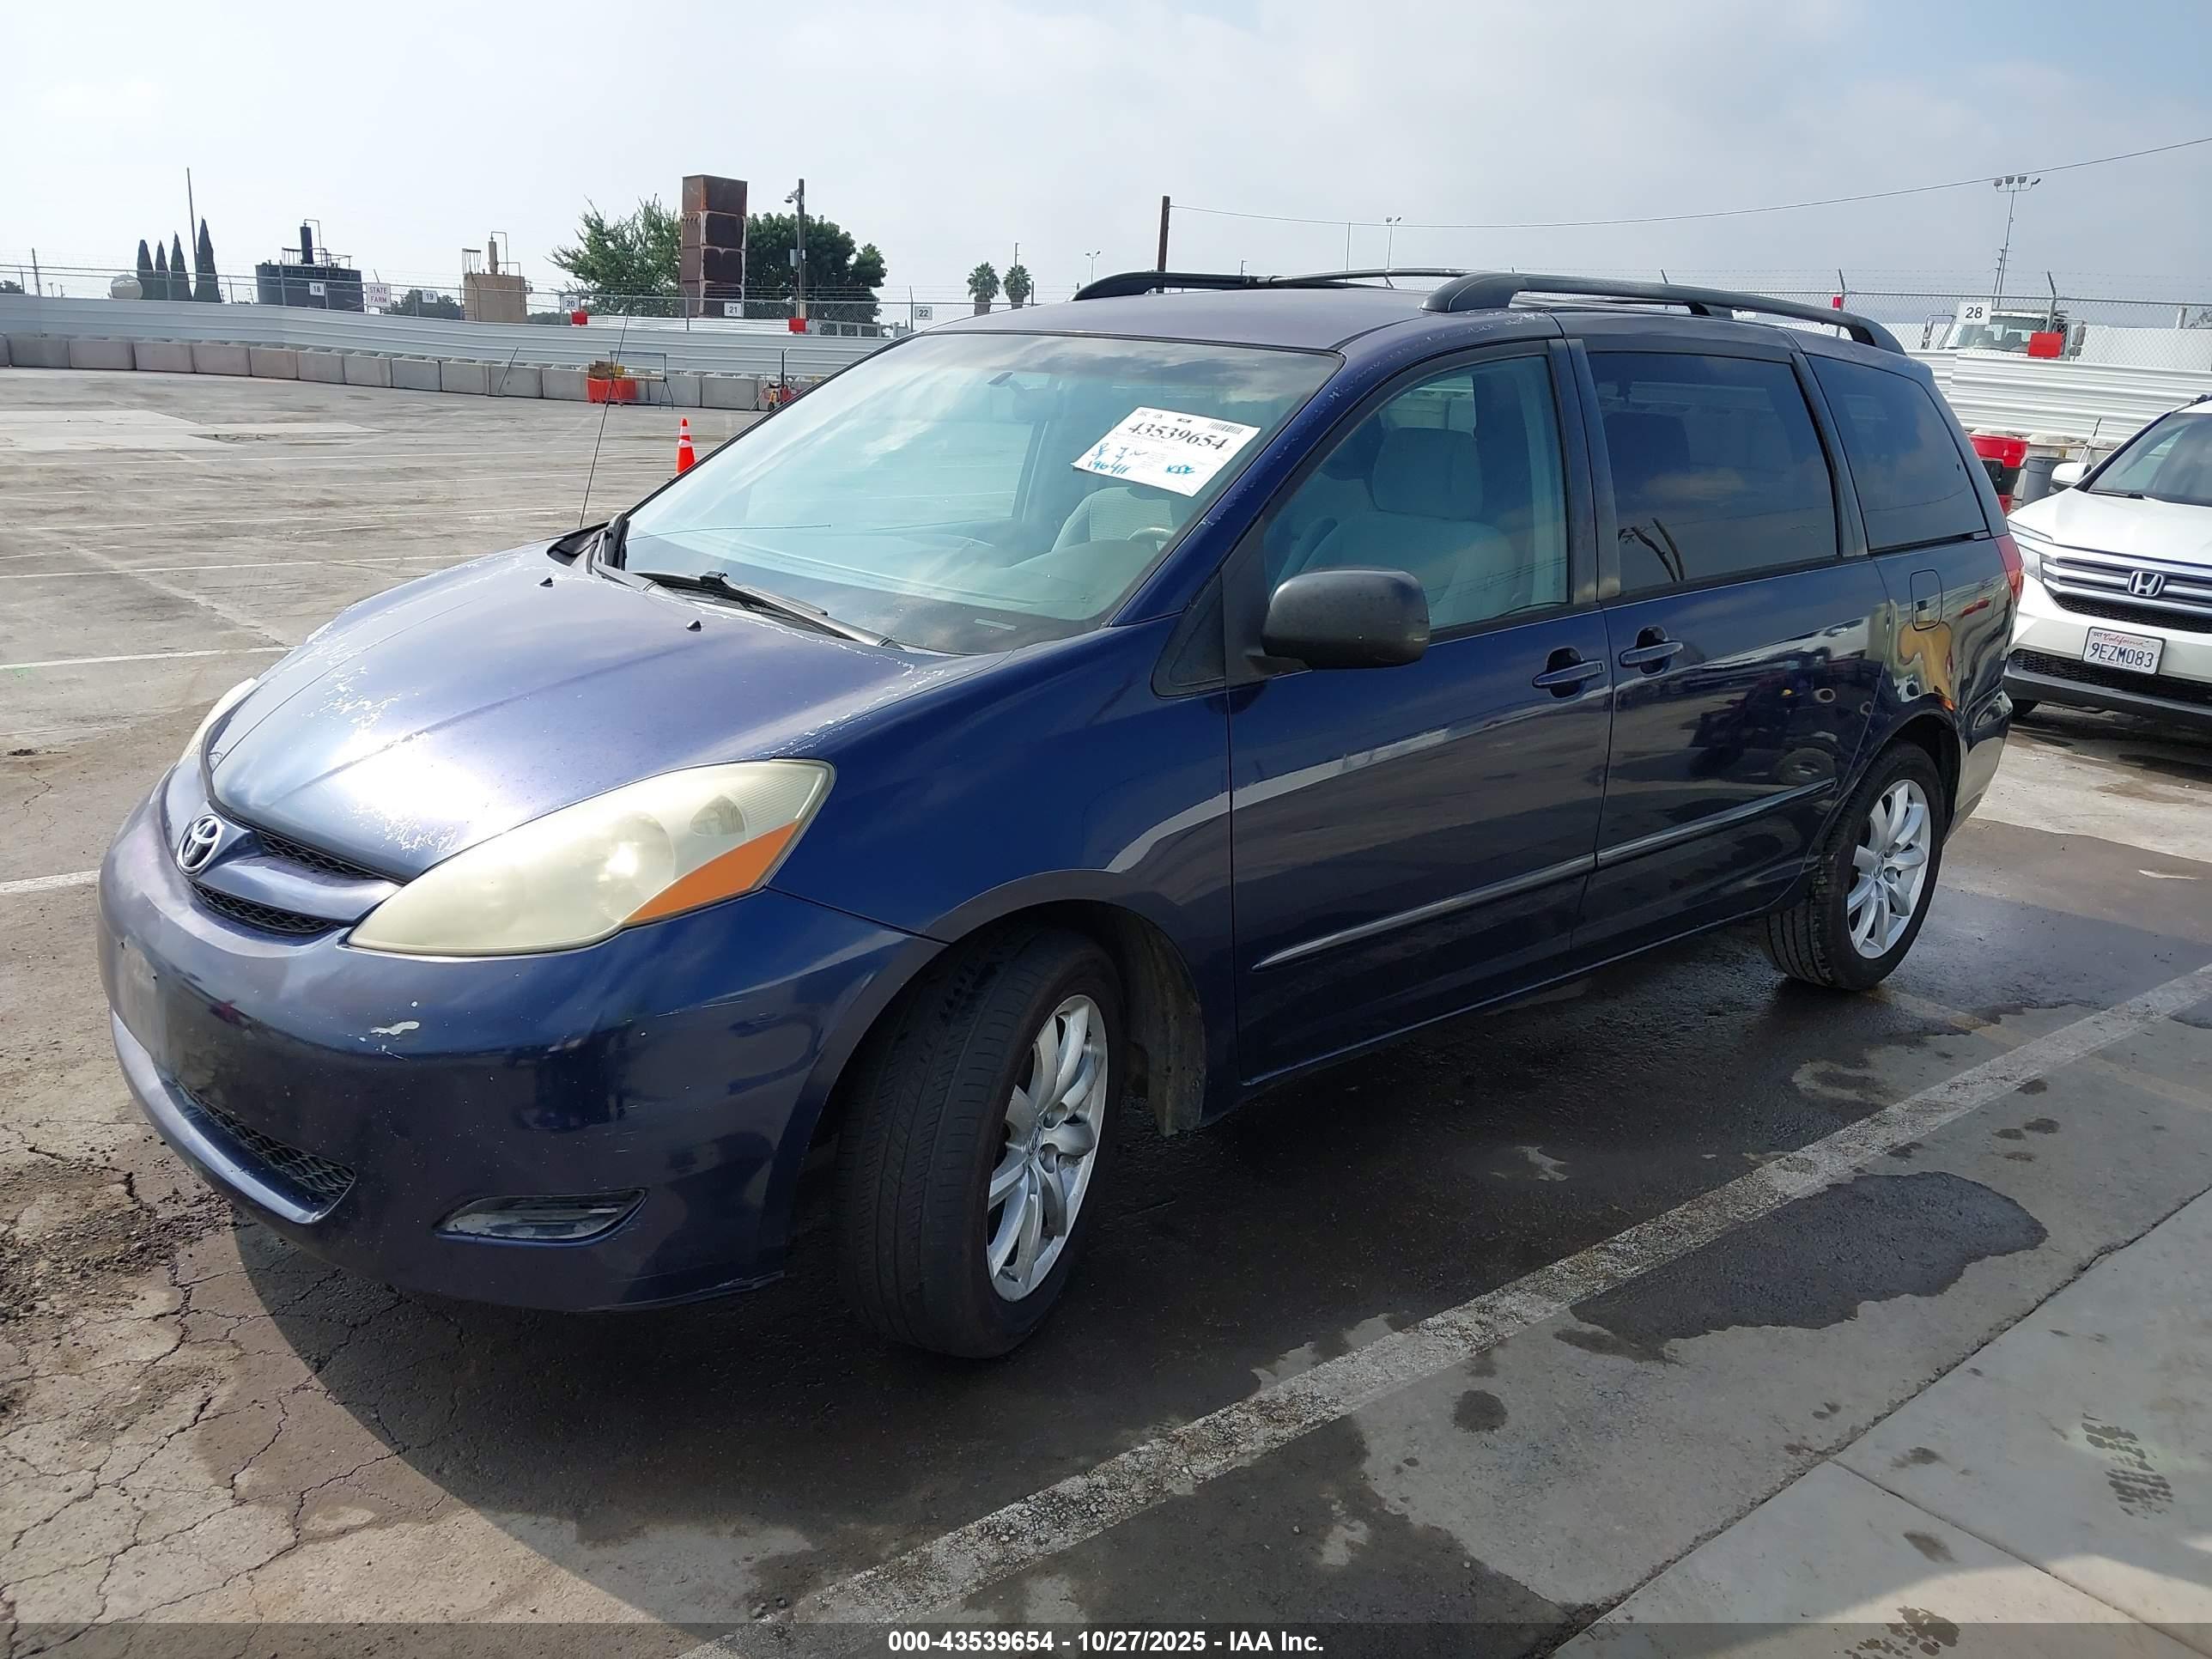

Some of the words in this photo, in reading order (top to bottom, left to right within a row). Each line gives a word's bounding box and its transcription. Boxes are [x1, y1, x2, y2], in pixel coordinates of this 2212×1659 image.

[369, 286, 387, 295] STATE
[919, 309, 929, 318] 22
[1966, 307, 1983, 319] 28
[1127, 422, 1229, 451] 43539654
[2089, 642, 2154, 668] 9EZM083
